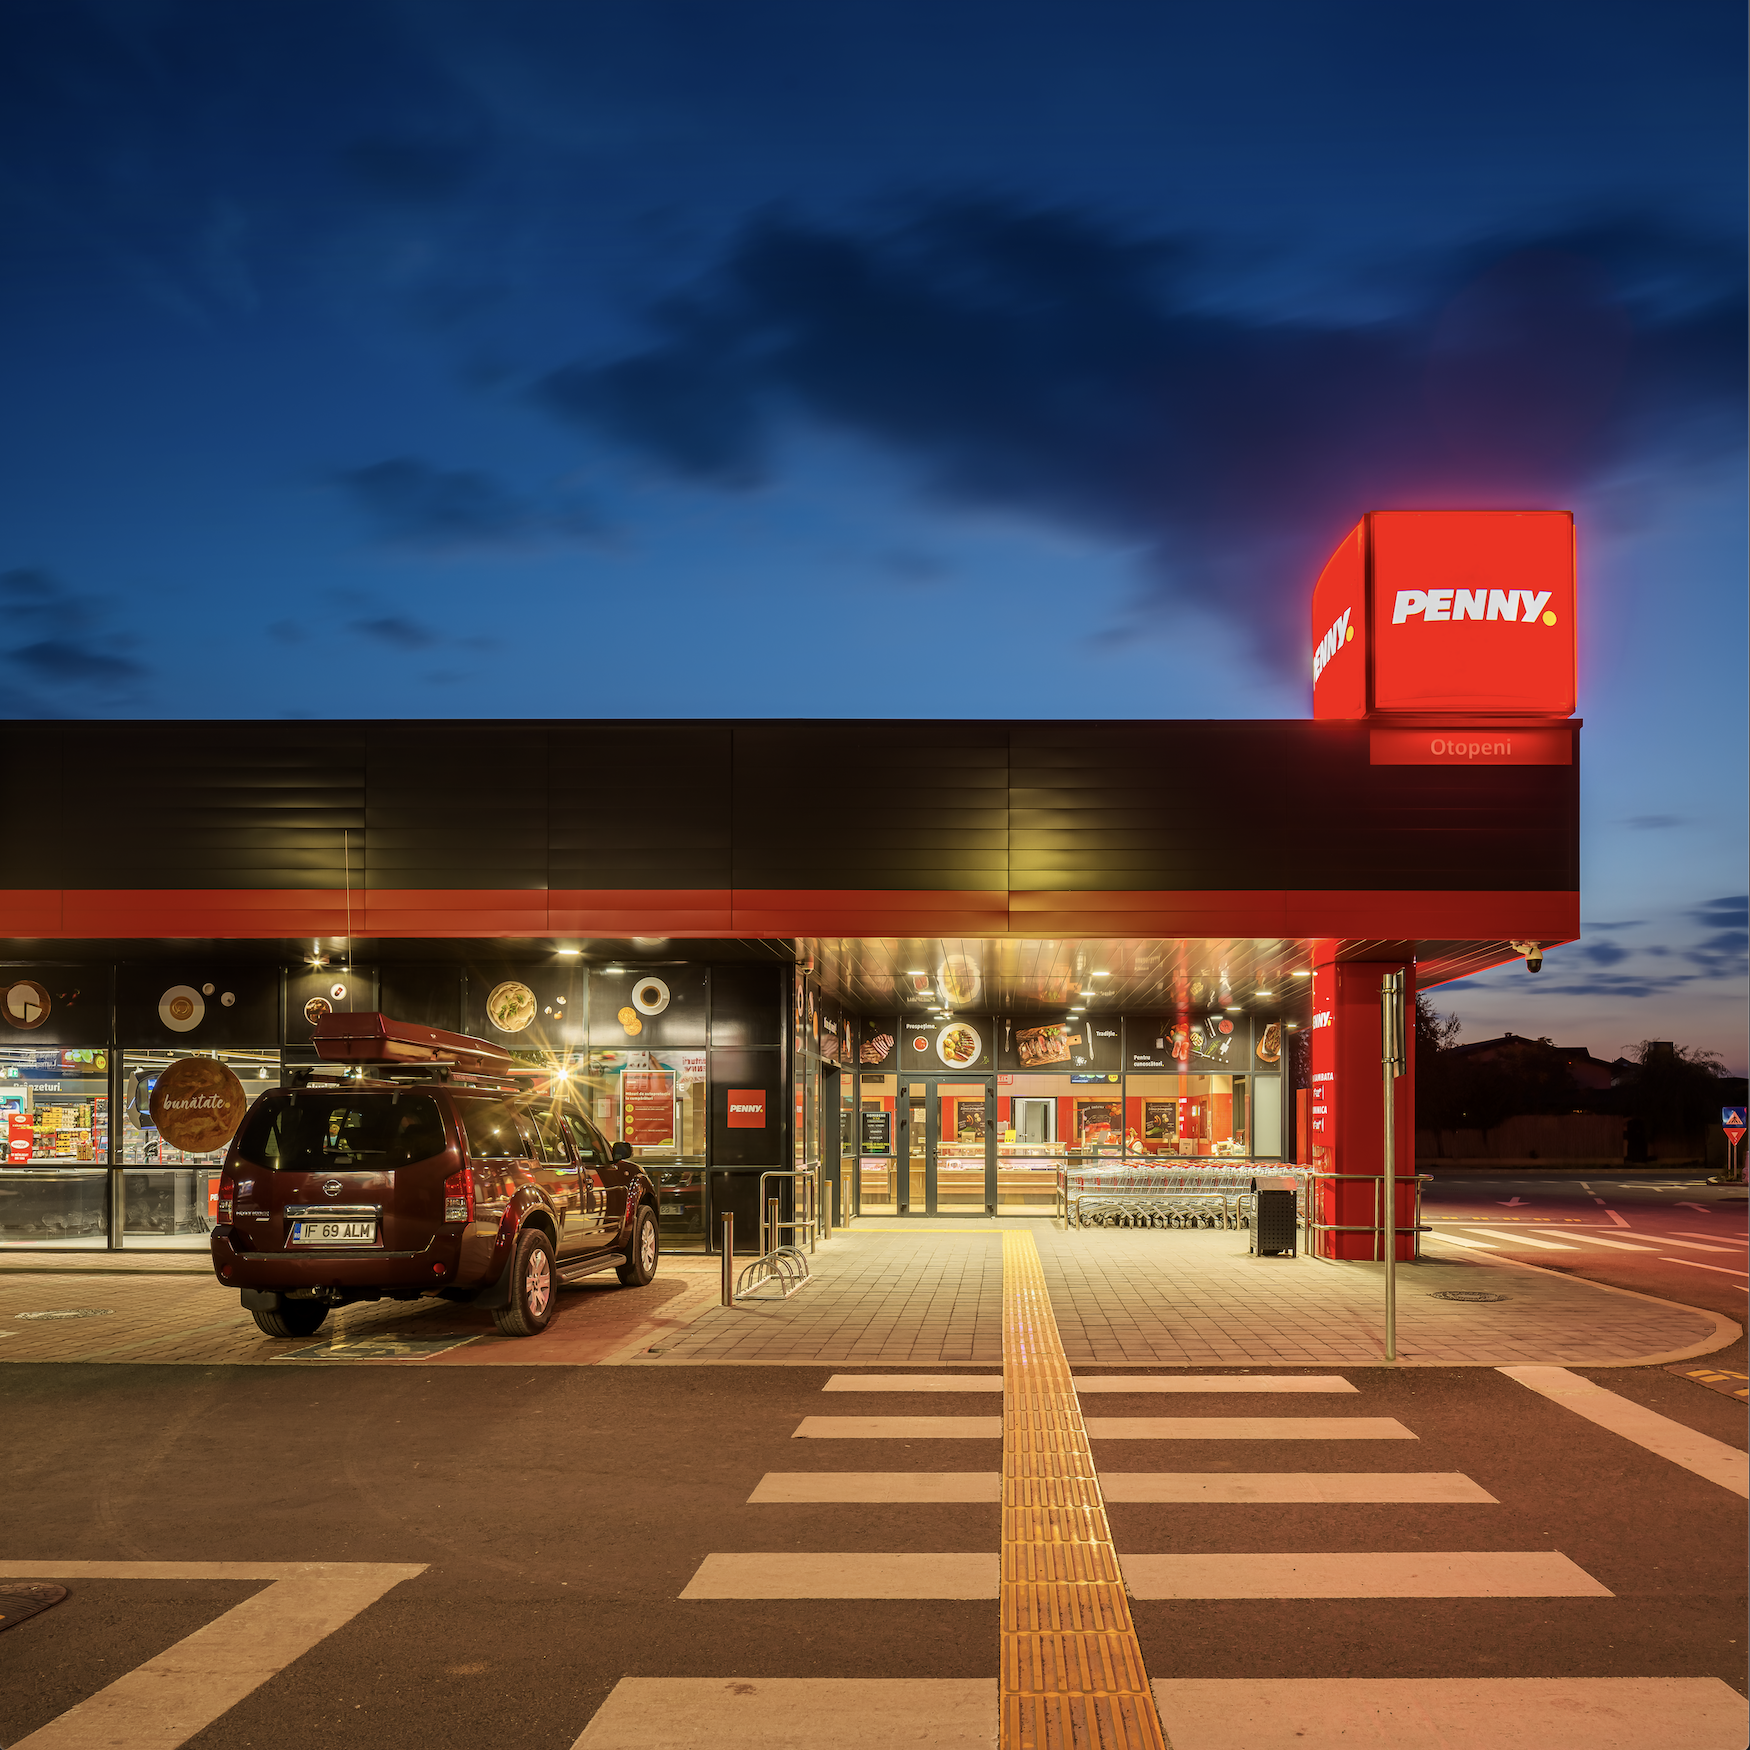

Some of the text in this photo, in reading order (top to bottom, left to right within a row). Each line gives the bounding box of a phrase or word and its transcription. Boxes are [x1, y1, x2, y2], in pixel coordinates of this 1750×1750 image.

[1313, 607, 1354, 691] ENNY.
[1430, 738, 1512, 759] Otopeni
[304, 1224, 370, 1238] IF 69 ALM
